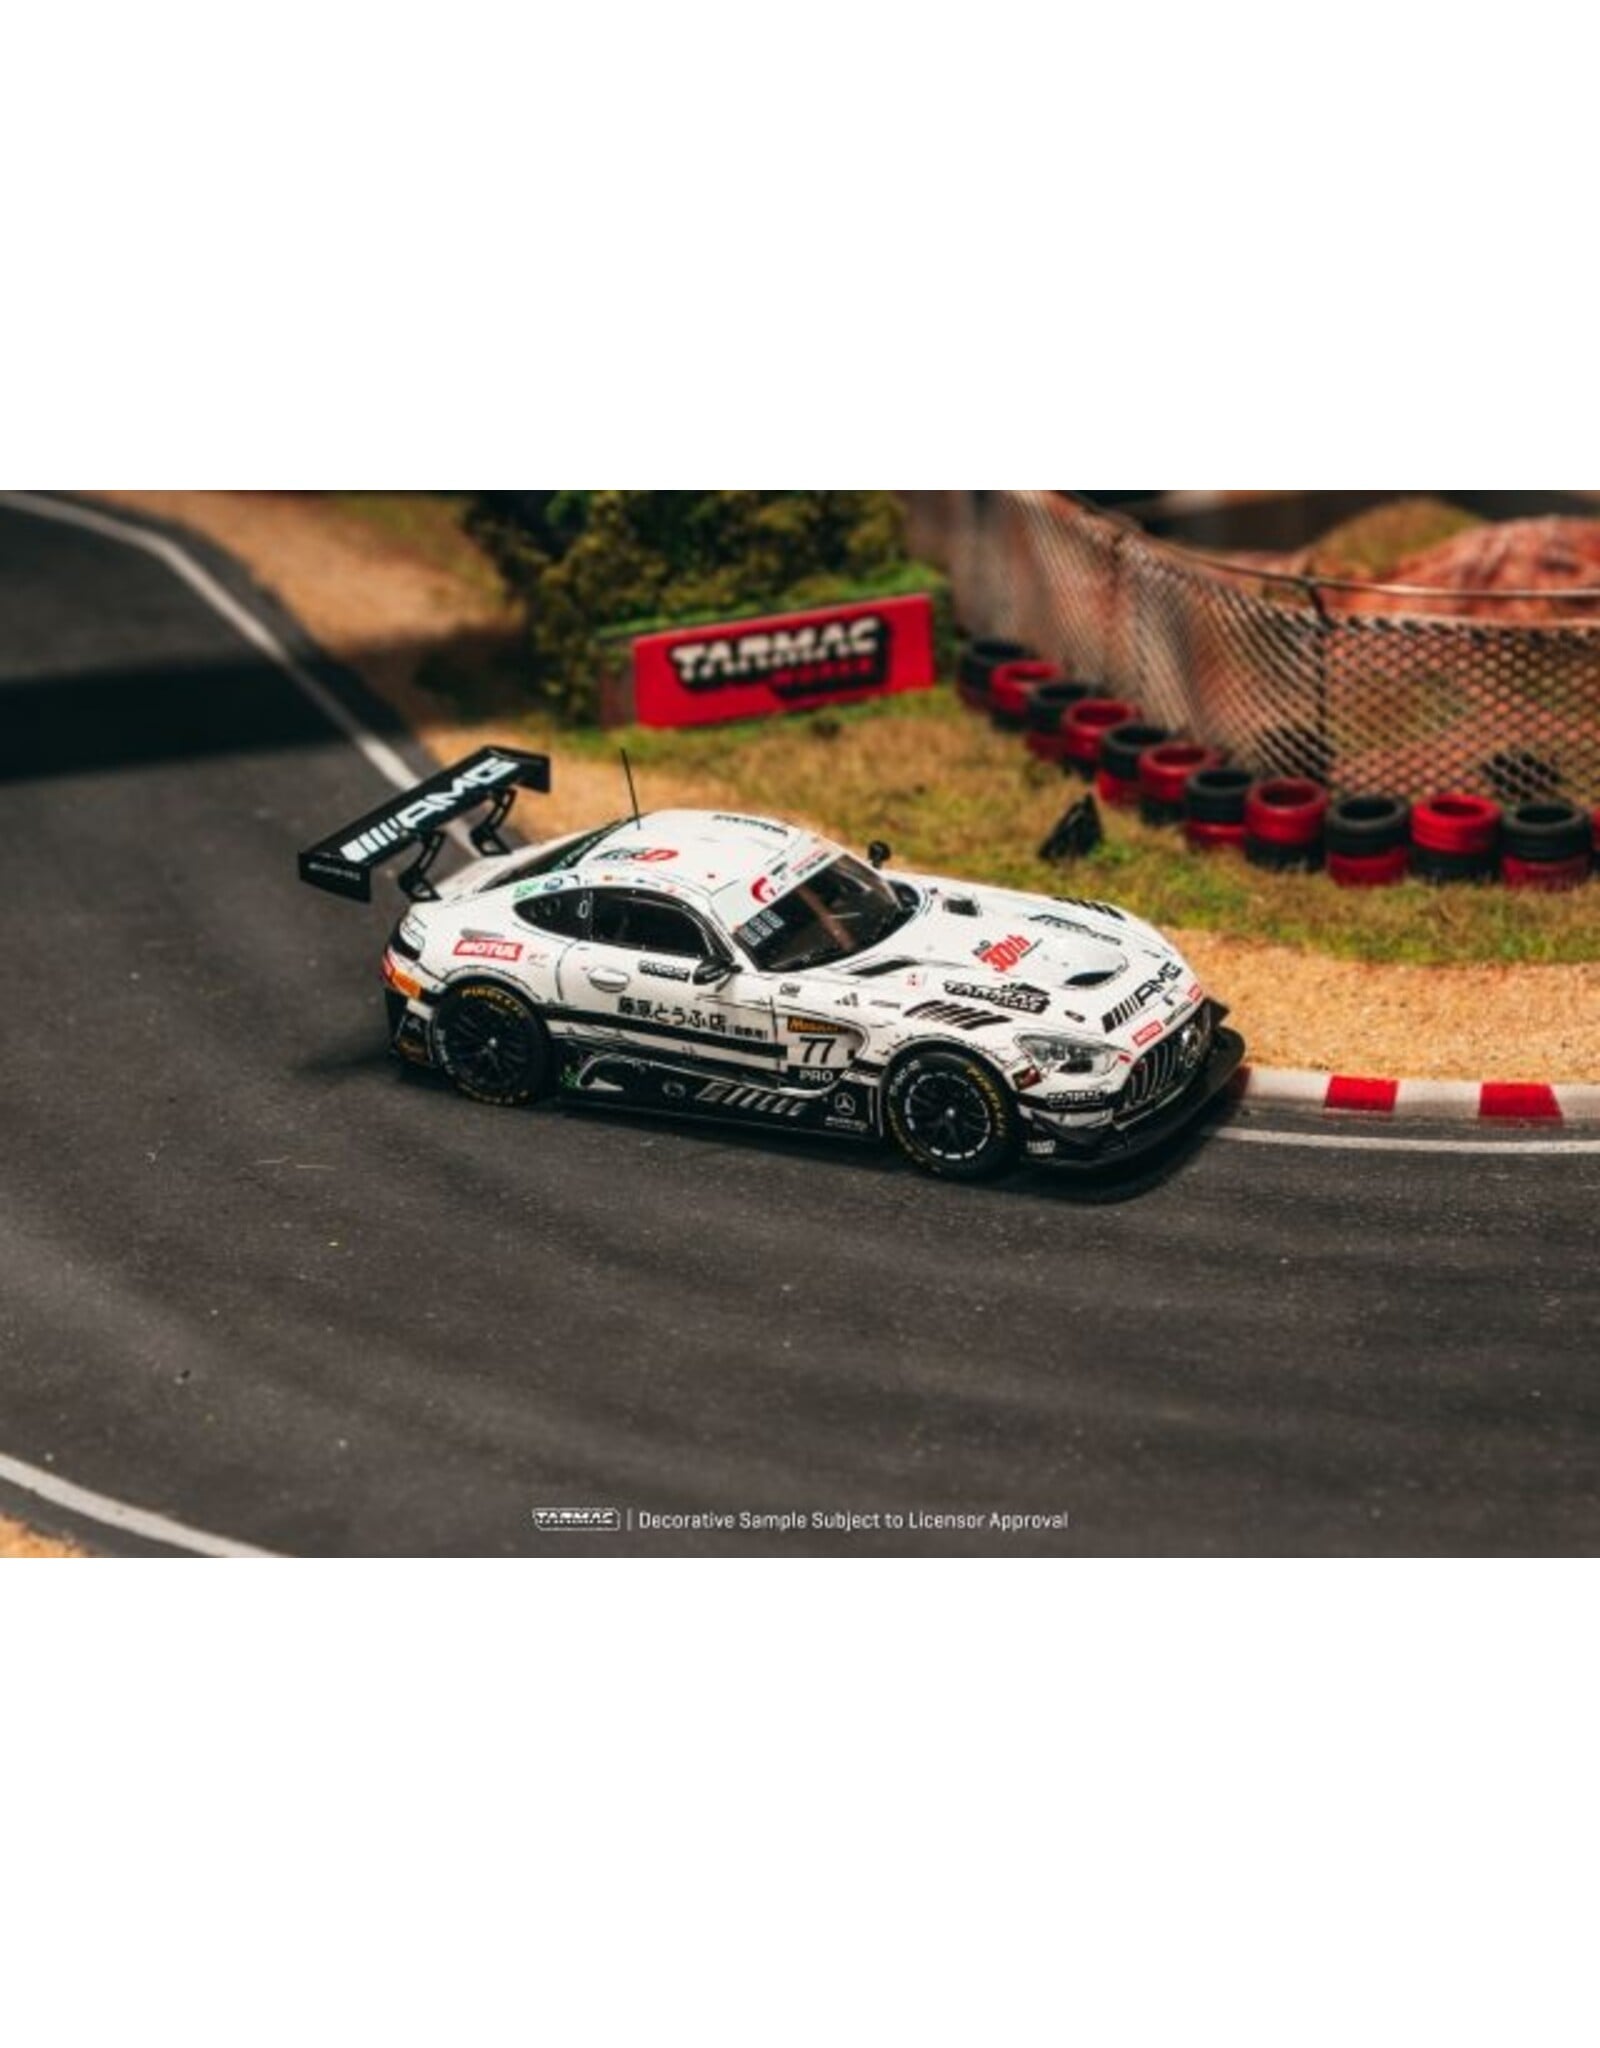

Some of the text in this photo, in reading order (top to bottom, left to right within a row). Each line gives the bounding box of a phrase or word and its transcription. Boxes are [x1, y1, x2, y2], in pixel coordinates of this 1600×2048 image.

[670, 616, 880, 683] TARMAC
[396, 757, 519, 829] AMG
[457, 941, 520, 959] MOTUL
[1134, 961, 1182, 1007] AMG
[799, 1036, 836, 1064] 77
[800, 1069, 835, 1082] PRO
